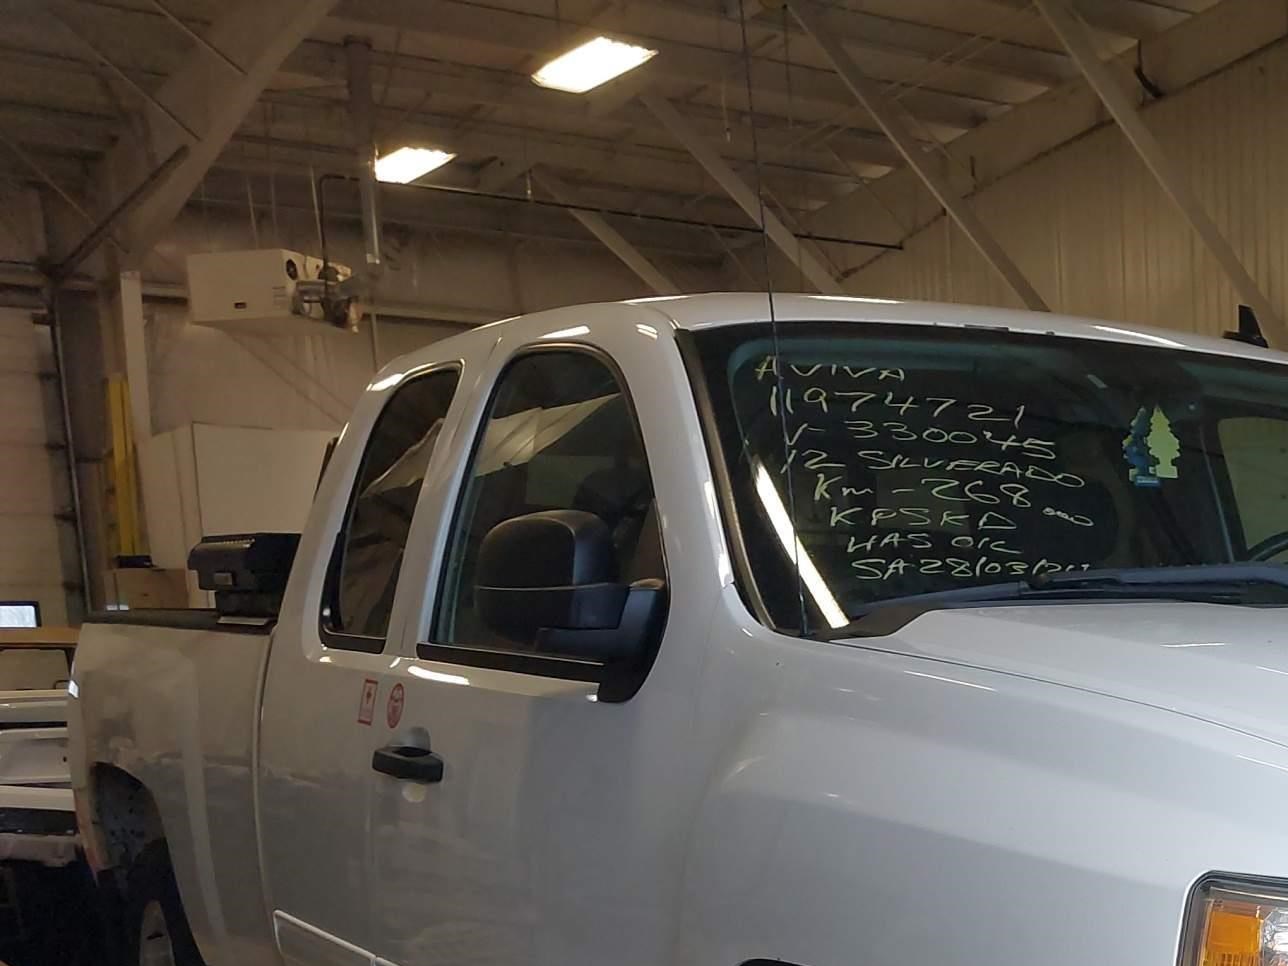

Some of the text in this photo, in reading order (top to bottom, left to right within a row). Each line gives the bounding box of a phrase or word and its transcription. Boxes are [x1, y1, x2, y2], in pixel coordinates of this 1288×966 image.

[755, 355, 906, 382] AVIVA
[769, 385, 1026, 430] 11974721
[844, 420, 1057, 460] 330045
[857, 450, 1086, 488] SILVERADO
[847, 532, 933, 553] HAS
